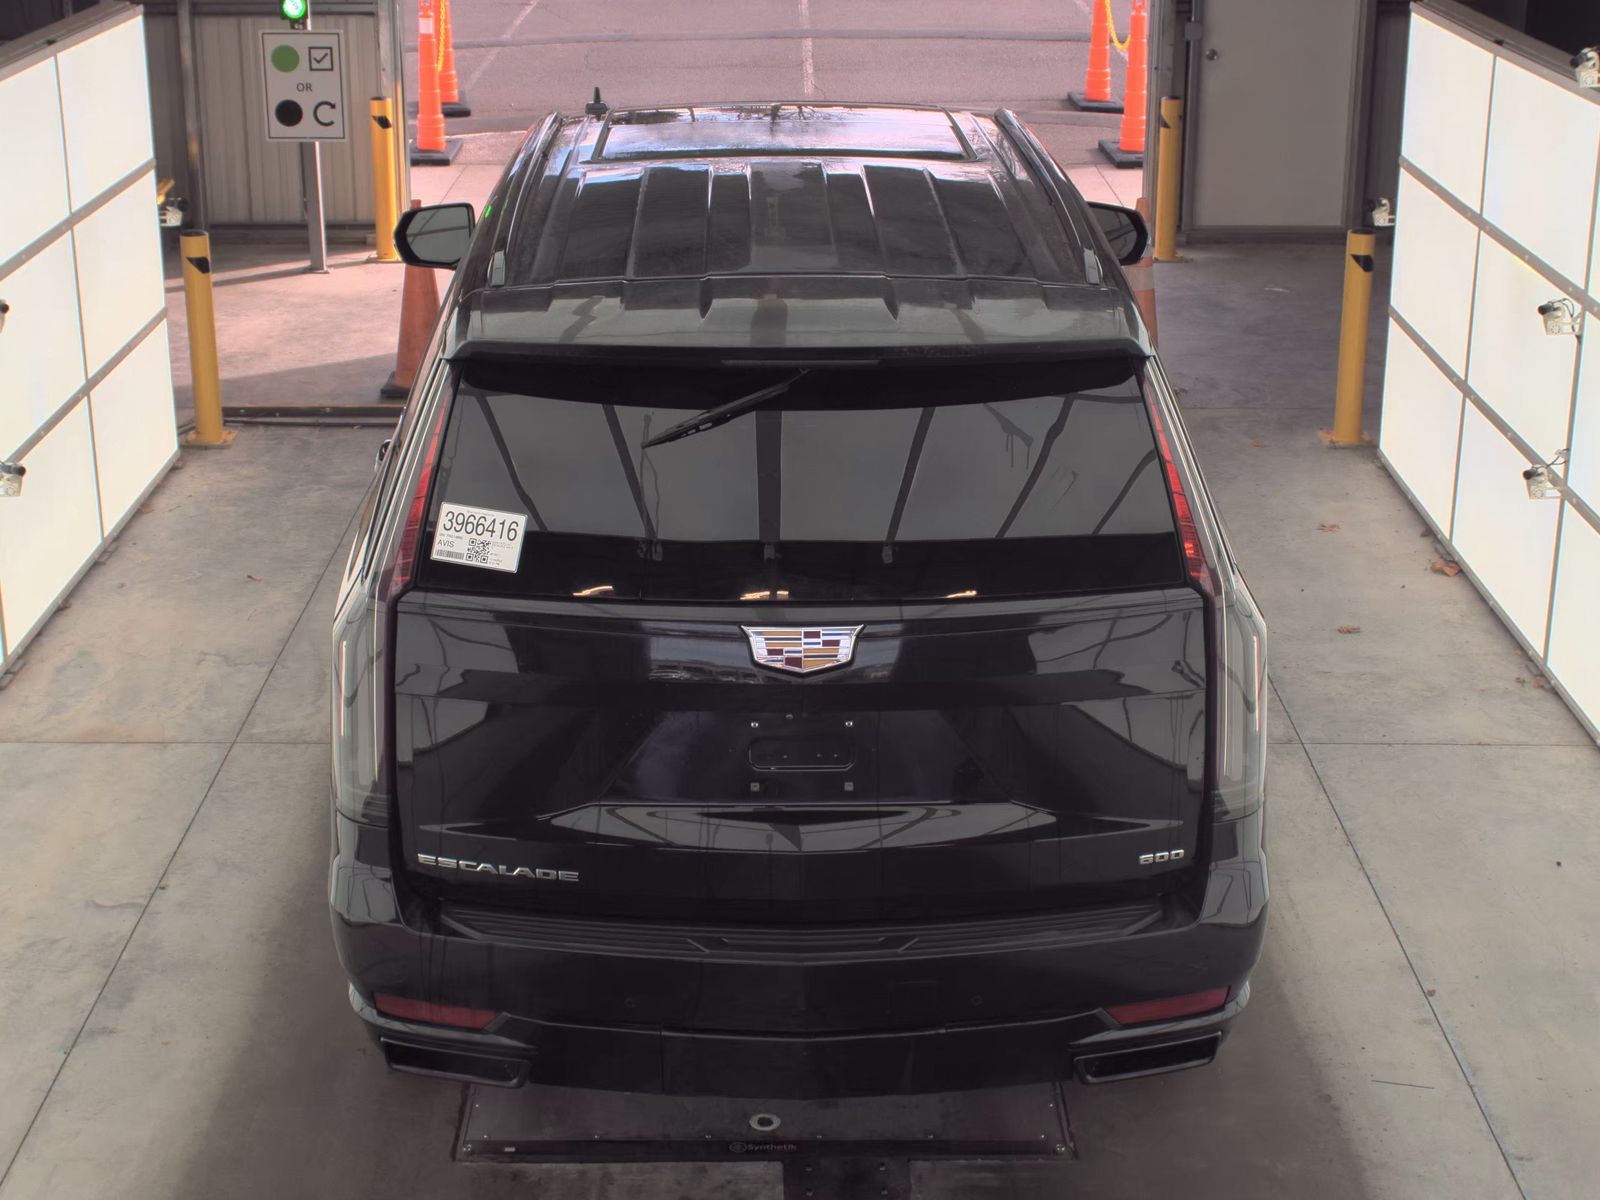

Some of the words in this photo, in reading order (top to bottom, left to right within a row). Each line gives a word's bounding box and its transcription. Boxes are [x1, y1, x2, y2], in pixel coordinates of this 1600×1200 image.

[296, 82, 313, 92] OR
[443, 510, 519, 542] 3966416
[437, 538, 455, 548] AVIS
[1138, 849, 1185, 865] 600
[417, 853, 580, 882] ESCALADE
